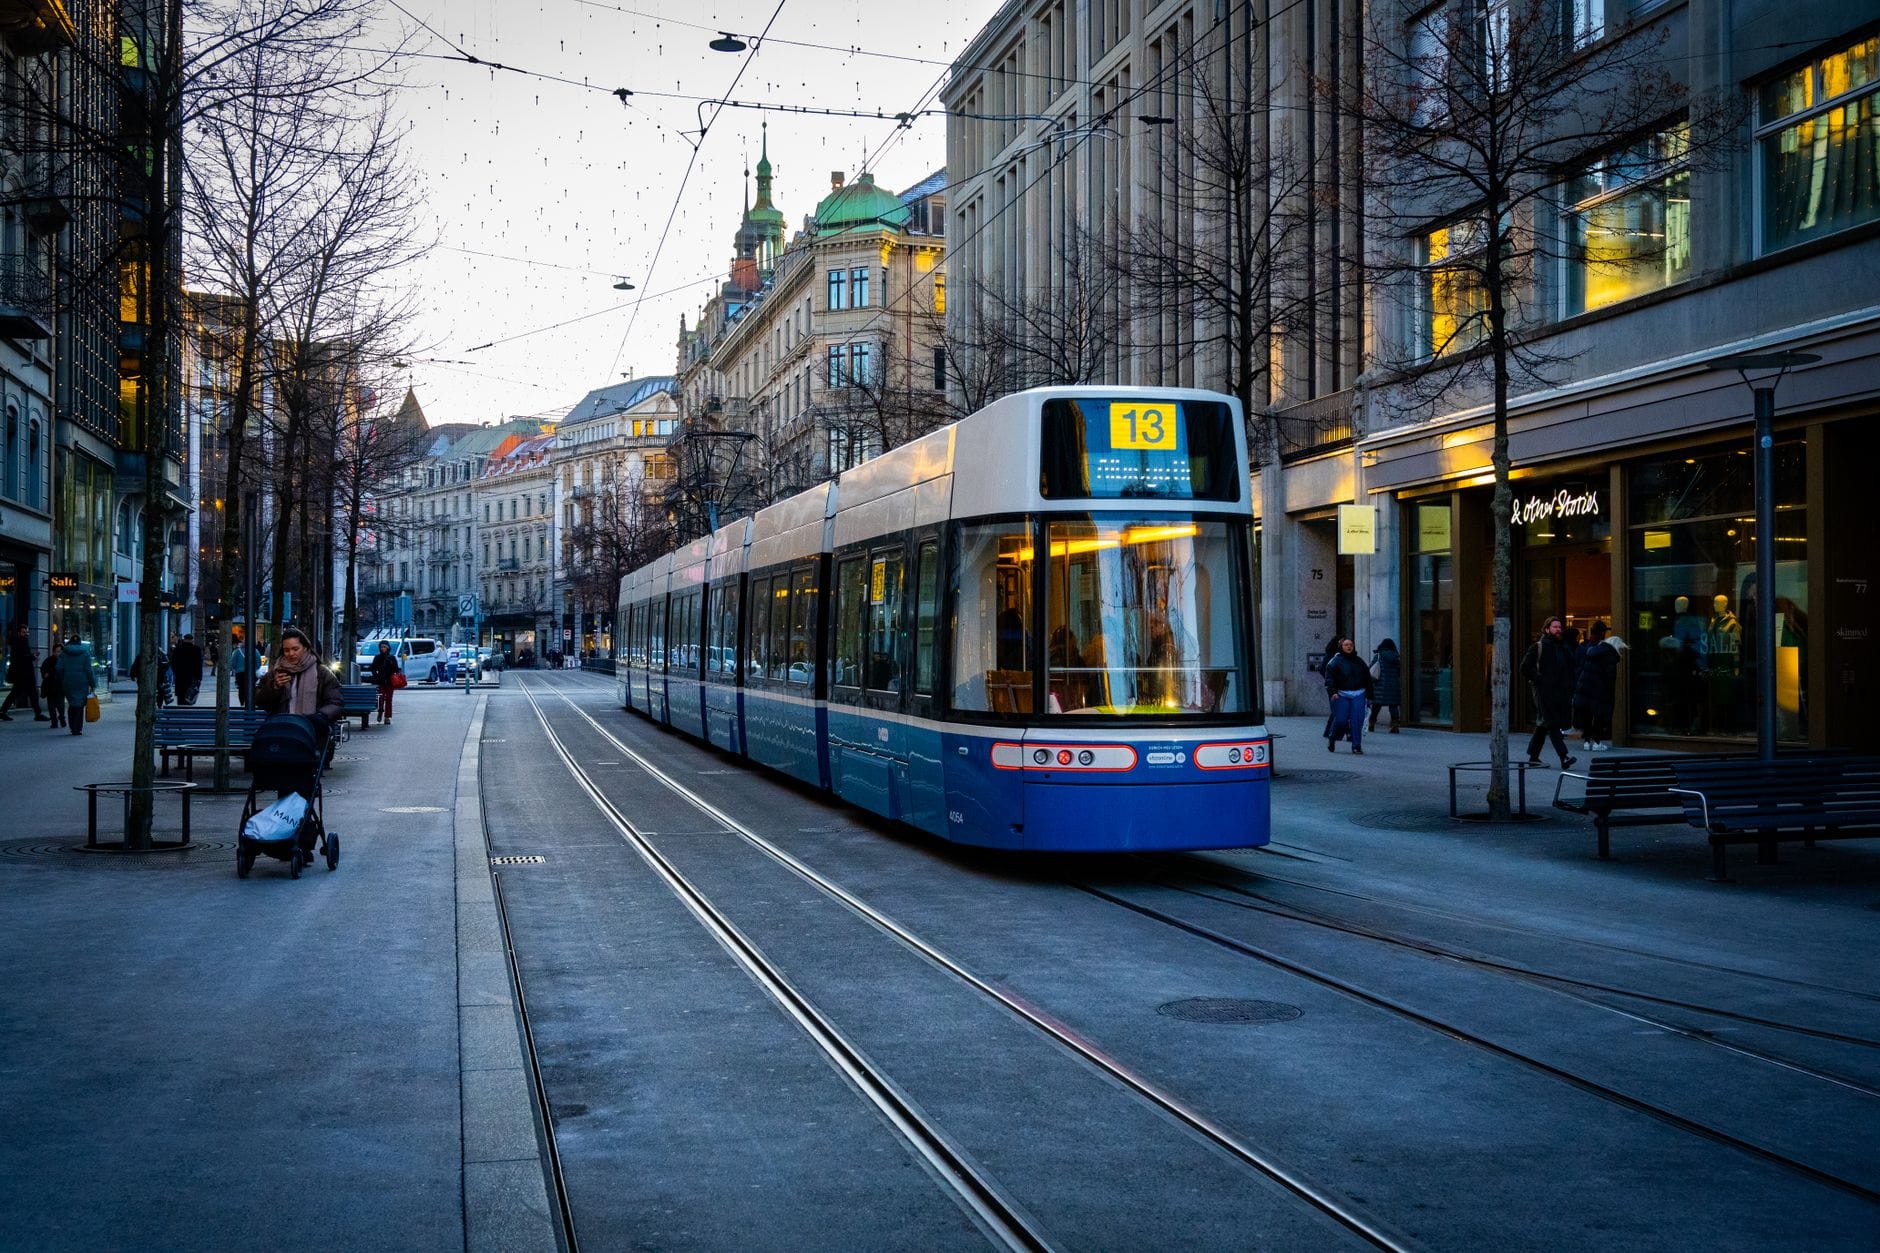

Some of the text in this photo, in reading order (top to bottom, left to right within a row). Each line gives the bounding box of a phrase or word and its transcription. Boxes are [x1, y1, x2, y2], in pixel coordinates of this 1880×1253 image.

[1122, 409, 1165, 443] 13
[1510, 489, 1600, 526] & other Stories
[50, 576, 77, 587] Salt.
[1311, 569, 1323, 580] 75
[1699, 631, 1740, 655] SALE
